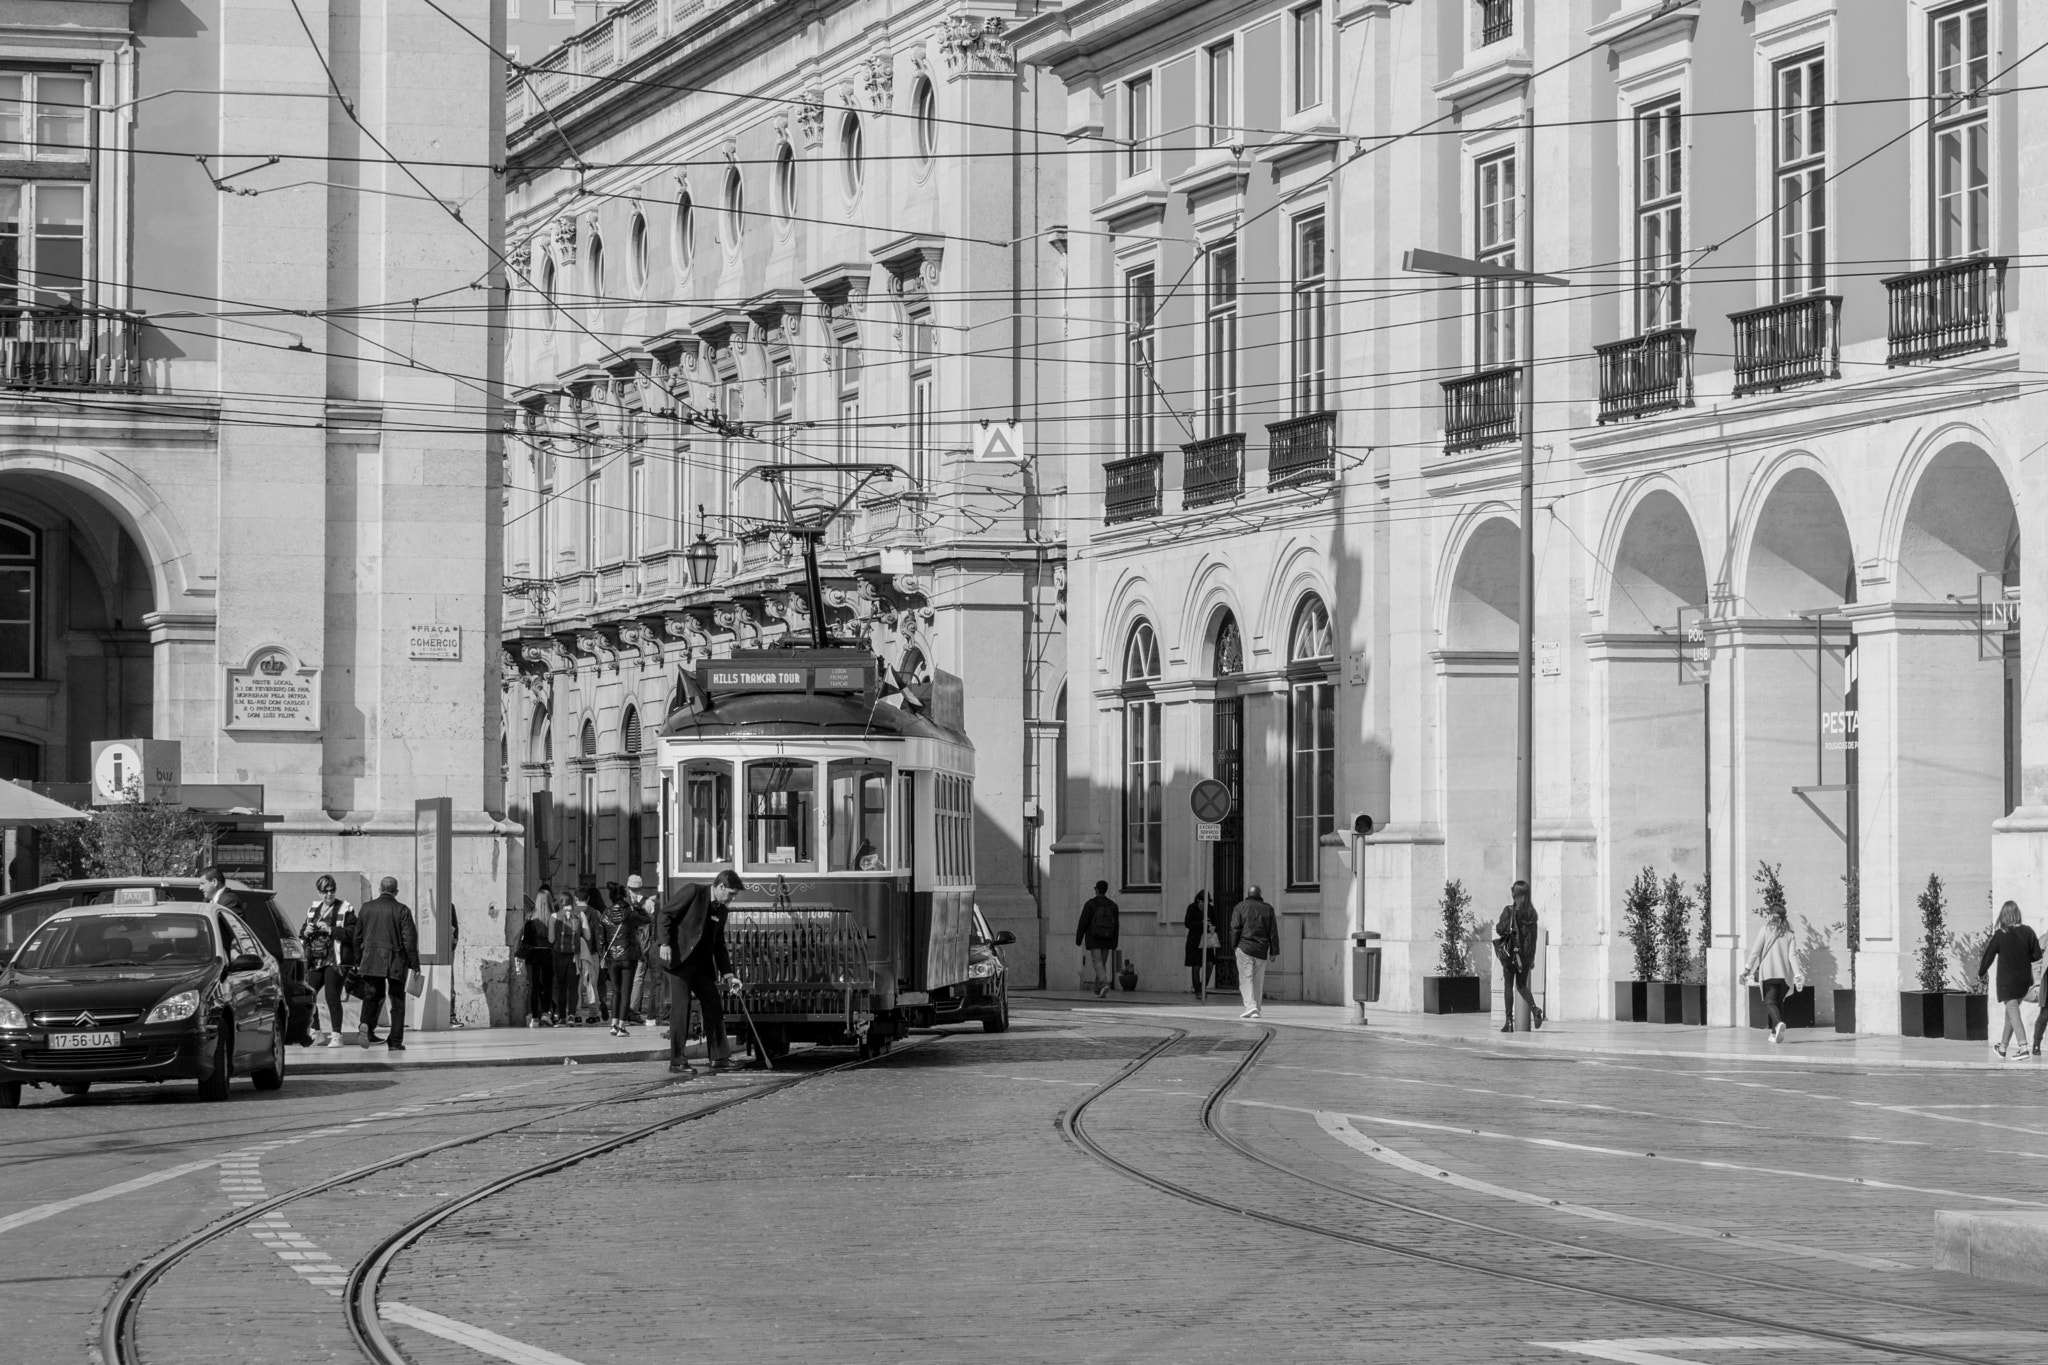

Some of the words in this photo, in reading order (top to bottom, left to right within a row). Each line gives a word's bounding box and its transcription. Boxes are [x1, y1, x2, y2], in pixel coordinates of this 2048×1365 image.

[417, 625, 451, 635] PRAÇA
[1688, 628, 1706, 643] POU
[713, 673, 738, 685] HILLS
[740, 673, 777, 685] TRAMCAR
[778, 672, 801, 684] TOUR
